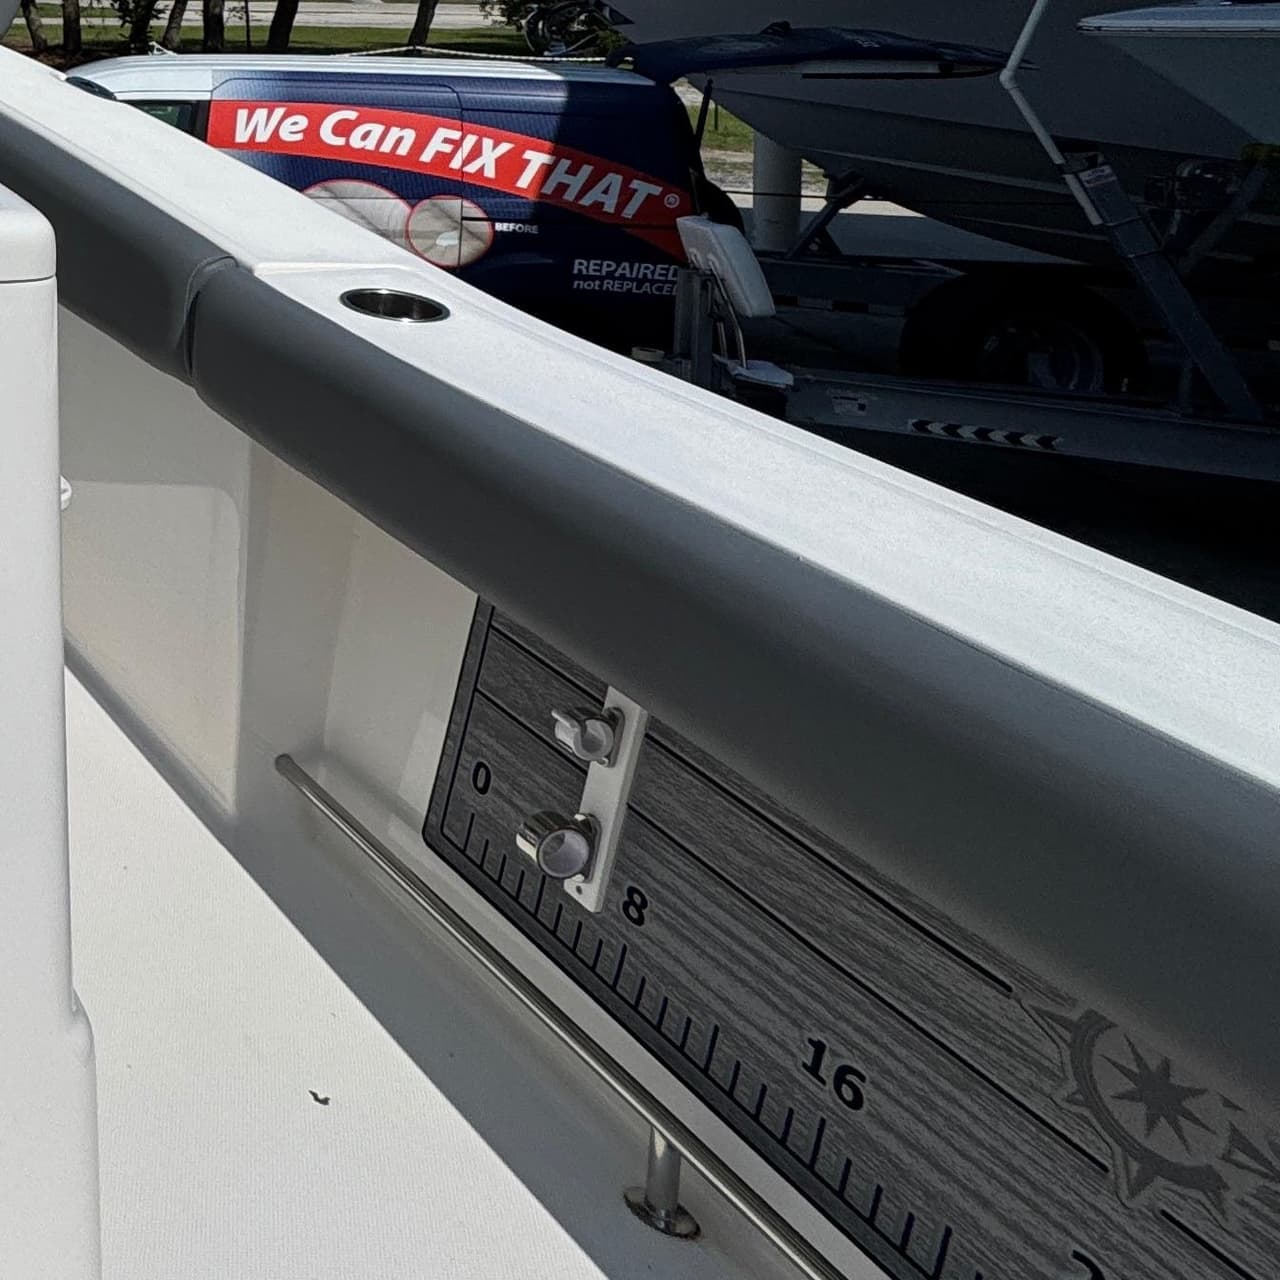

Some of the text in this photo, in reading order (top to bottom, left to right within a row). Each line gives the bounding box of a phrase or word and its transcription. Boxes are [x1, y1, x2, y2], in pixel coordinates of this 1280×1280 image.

[234, 107, 309, 143] We
[319, 110, 417, 156] Can
[418, 127, 514, 179] FIX
[495, 222, 539, 234] BEFORE
[572, 280, 600, 291] not
[472, 761, 867, 1111] 0 8 16
